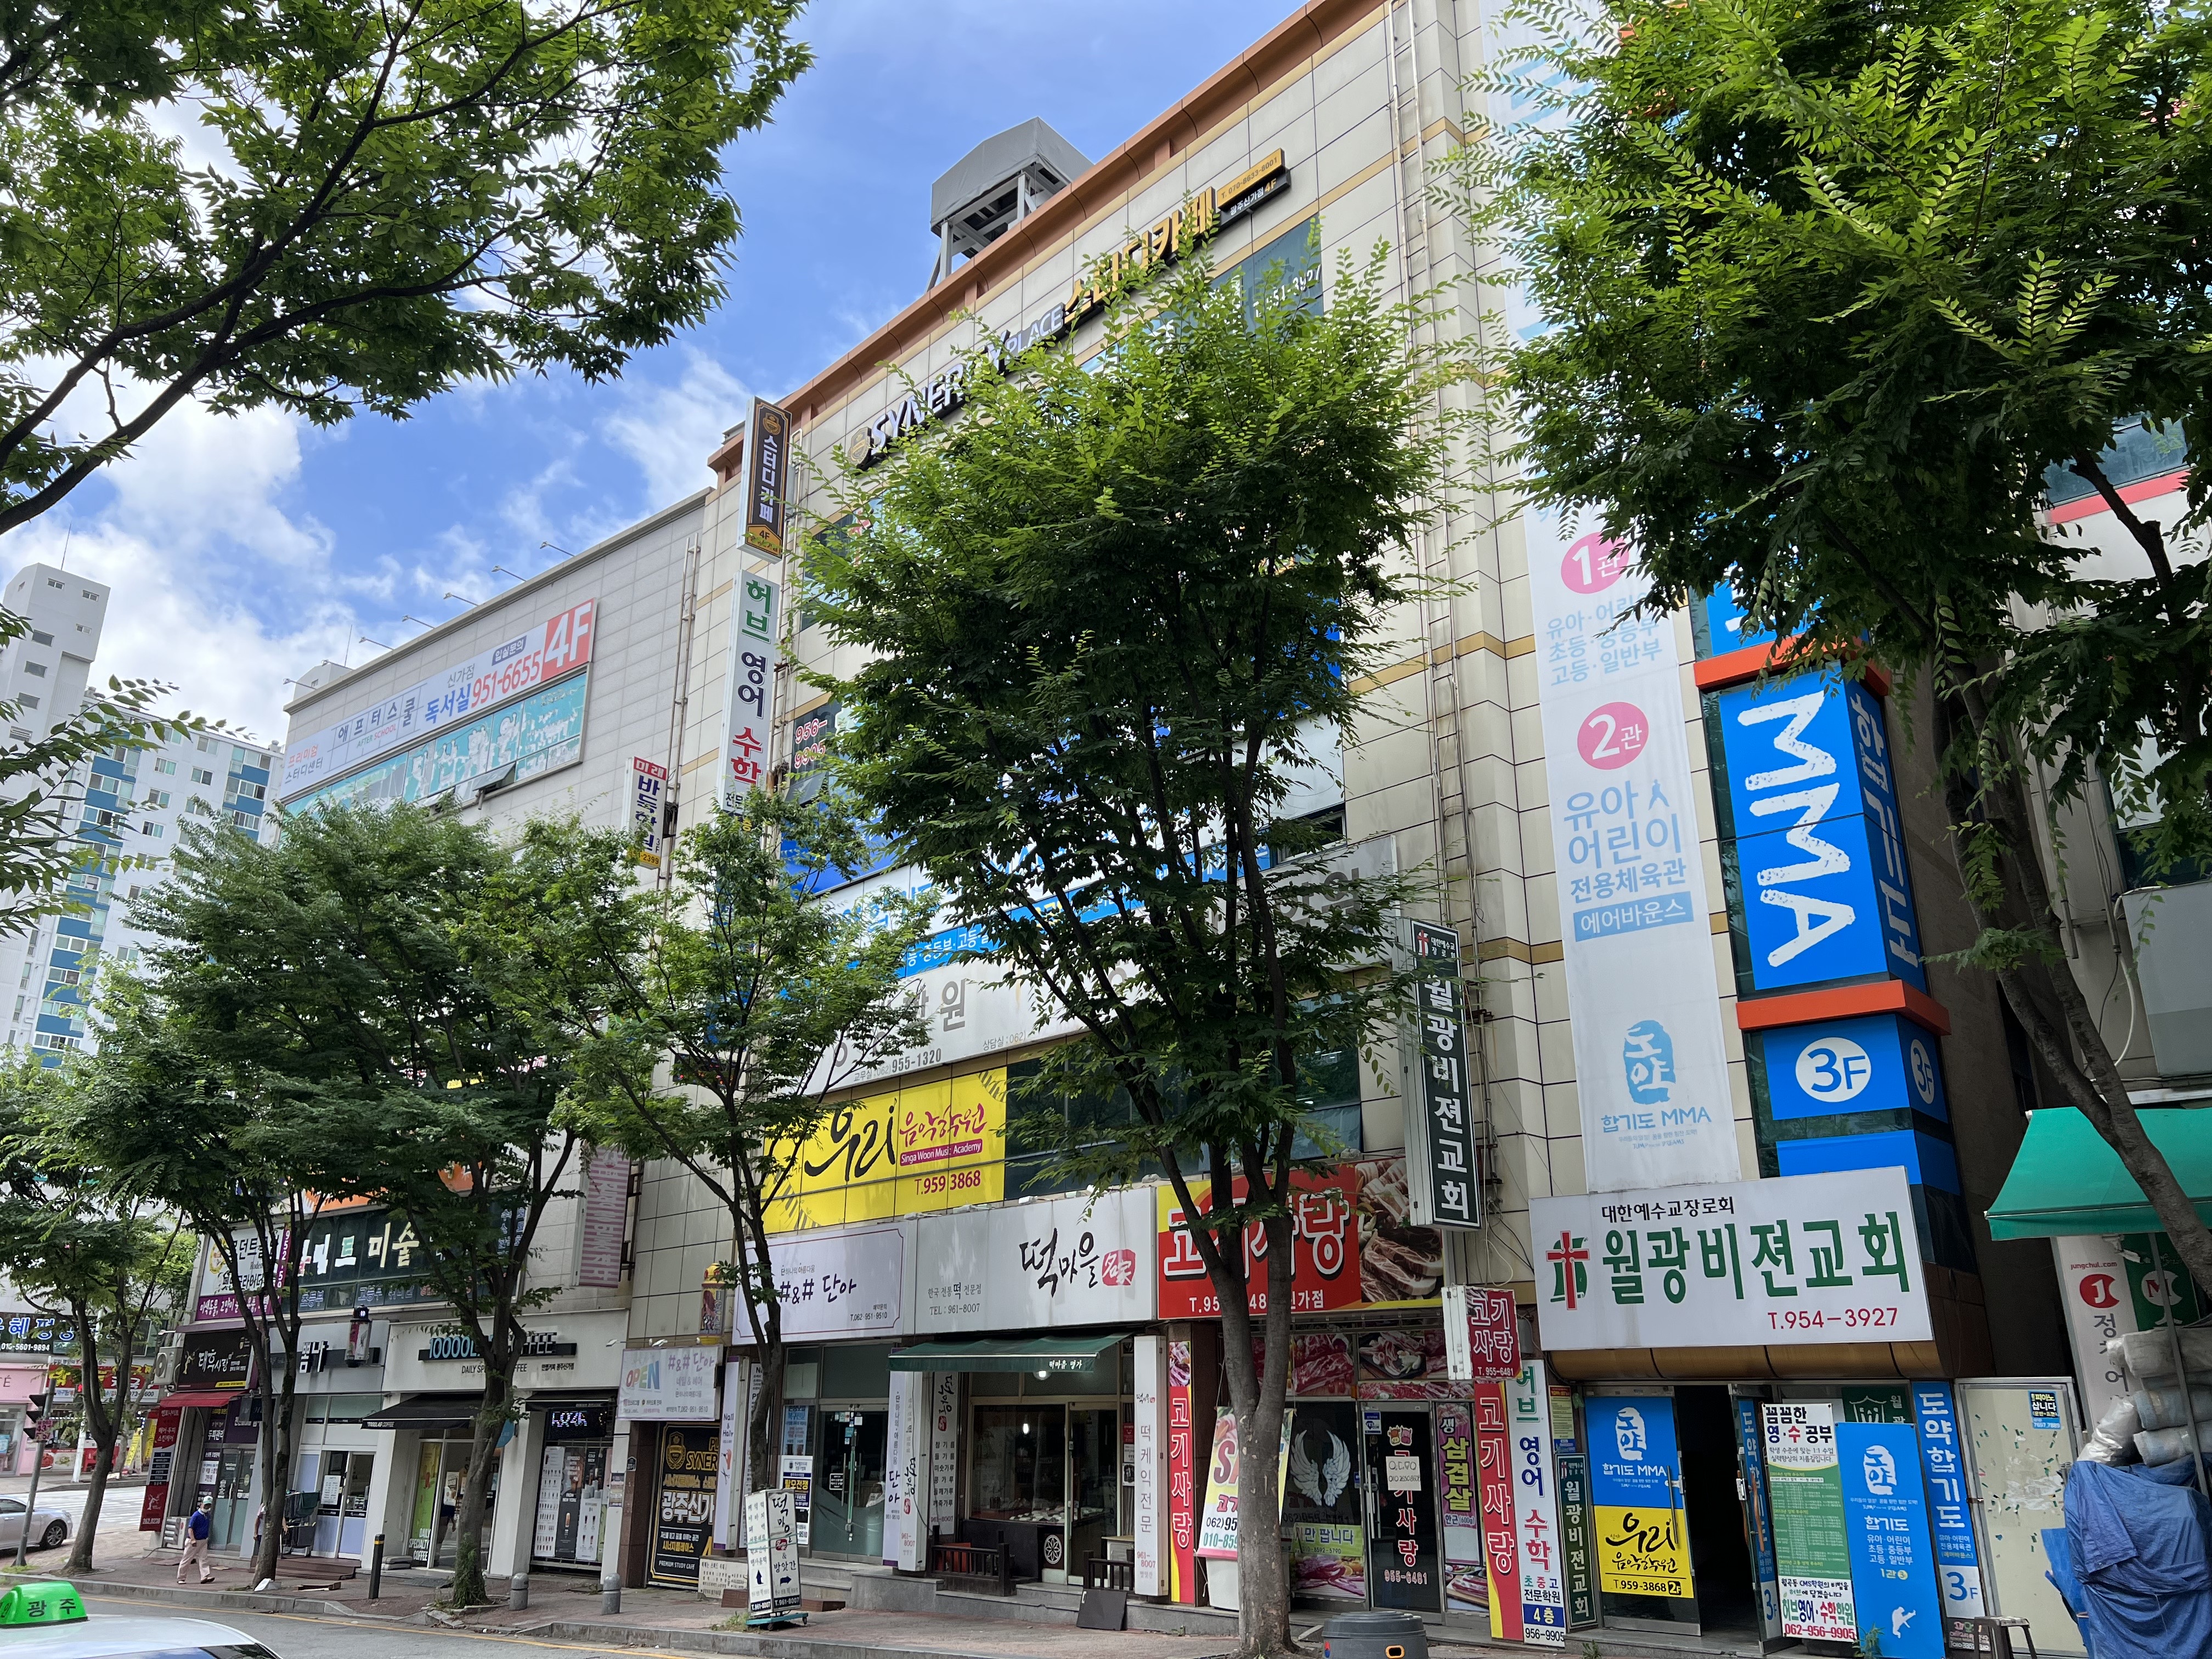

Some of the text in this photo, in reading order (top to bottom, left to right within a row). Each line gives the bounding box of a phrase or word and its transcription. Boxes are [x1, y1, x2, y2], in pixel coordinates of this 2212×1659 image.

[1228, 157, 1278, 195] 070-8633-8001
[1229, 178, 1277, 216] 광주신가점 4F
[1007, 304, 1063, 357] PLACE
[1064, 187, 1212, 324] 스터디카페
[759, 435, 777, 523] 스터디카페
[759, 531, 770, 540] 4F
[1572, 545, 1621, 586] 1관
[742, 580, 771, 642] 허브
[545, 602, 591, 668] 4F
[494, 639, 524, 662] 입실문의
[447, 663, 476, 687] 신가점
[737, 652, 766, 719] 영어
[338, 650, 540, 742] 애프터스쿨 독서실 951-6655
[357, 724, 396, 748] AFTER SCHOOL
[795, 719, 827, 744] 956-
[1588, 713, 1643, 760] 2관
[288, 744, 318, 767] 프리미엄
[732, 727, 763, 786] 수학
[794, 742, 826, 768] 9905
[285, 757, 323, 783] 스터디센터
[636, 760, 664, 778] 미래
[1564, 781, 1639, 832] 유아
[1568, 813, 1681, 869] 어린이
[1737, 691, 1855, 968] MMA
[1570, 857, 1686, 904] 전용체육관
[1581, 899, 1686, 934] 에어바운스
[1431, 937, 1455, 950] 대한예수교
[1432, 946, 1455, 958] 장로회
[983, 1035, 1004, 1051] 상담실
[854, 1048, 941, 1082] 교무실 955-1320
[1807, 1048, 1866, 1093] 3F
[1913, 1047, 1934, 1096] 3F
[1601, 1106, 1712, 1133] 합기도 MMA
[804, 1098, 987, 1181] 우리 음악학원
[901, 1141, 981, 1164] Singa Woori Academy
[950, 1170, 980, 1190] 3868
[1602, 1196, 1735, 1223] 대한예수교장로회
[368, 1222, 420, 1268] 미술
[1019, 1227, 1101, 1298] 떡마을
[1602, 1211, 1910, 1305] 월광비젼교회
[2071, 1262, 2118, 1270] jungchul.com
[822, 1273, 856, 1302] 단아
[928, 1282, 981, 1300] 한국 전통 떡 전문점
[948, 1304, 980, 1313] 961-8007
[1471, 1298, 1510, 1330] 고기
[1474, 1330, 1513, 1363] 사랑
[693, 1352, 714, 1372] 단아
[1070, 1359, 1082, 1369] 명가
[1486, 1367, 1514, 1376] 955-6481
[626, 1361, 660, 1390] OPEN
[676, 1376, 685, 1386] 네일
[692, 1376, 702, 1386] 헤어
[1766, 1407, 1807, 1424] 꼼꼼한
[2032, 1402, 2056, 1411] 삽니다
[1806, 1425, 1832, 1443] 공부
[1440, 1417, 1472, 1512] 생 삼겹살
[1602, 1463, 1667, 1477] 합기도 MMA
[1919, 1392, 1965, 1528] 도약합기도
[785, 1480, 809, 1489] 탈모전쟁
[1170, 1398, 1192, 1549] 고기사랑
[1479, 1397, 1514, 1574] 고기사랑
[889, 1470, 900, 1503] 단아
[1520, 1436, 1552, 1571] 영어 수학
[772, 1494, 792, 1543] 떡마을
[1864, 1515, 1909, 1531] 합기도
[409, 1539, 430, 1549] SPECIALTY
[419, 1528, 431, 1538] DAILY
[1319, 1528, 1353, 1545] 팝니다
[1606, 1513, 1676, 1553] 우리
[413, 1550, 428, 1561] COFFEE
[1565, 1481, 1589, 1617] 월광비젼교회
[1940, 1543, 1971, 1551] 전용체육관
[659, 1560, 674, 1568] PREMIUM
[674, 1561, 685, 1569] STUDY
[774, 1562, 796, 1573] 방앗간
[1141, 1560, 1156, 1568] 8007
[1612, 1551, 1679, 1573] 음악학원
[1384, 1570, 1427, 1584] 955-6481
[1669, 1582, 1681, 1594] 2F
[1782, 1578, 1798, 1587] 월곡동
[1800, 1581, 1830, 1589] CMS학원의
[1946, 1572, 1978, 1601] 3F
[27, 1599, 77, 1617] 광주
[1525, 1589, 1561, 1604] 전문학원
[1764, 1589, 1778, 1621] 3F
[1533, 1607, 1555, 1624] 4층
[1525, 1627, 1564, 1643] 956-9905
[1785, 1624, 1855, 1639] 062-956-9905
